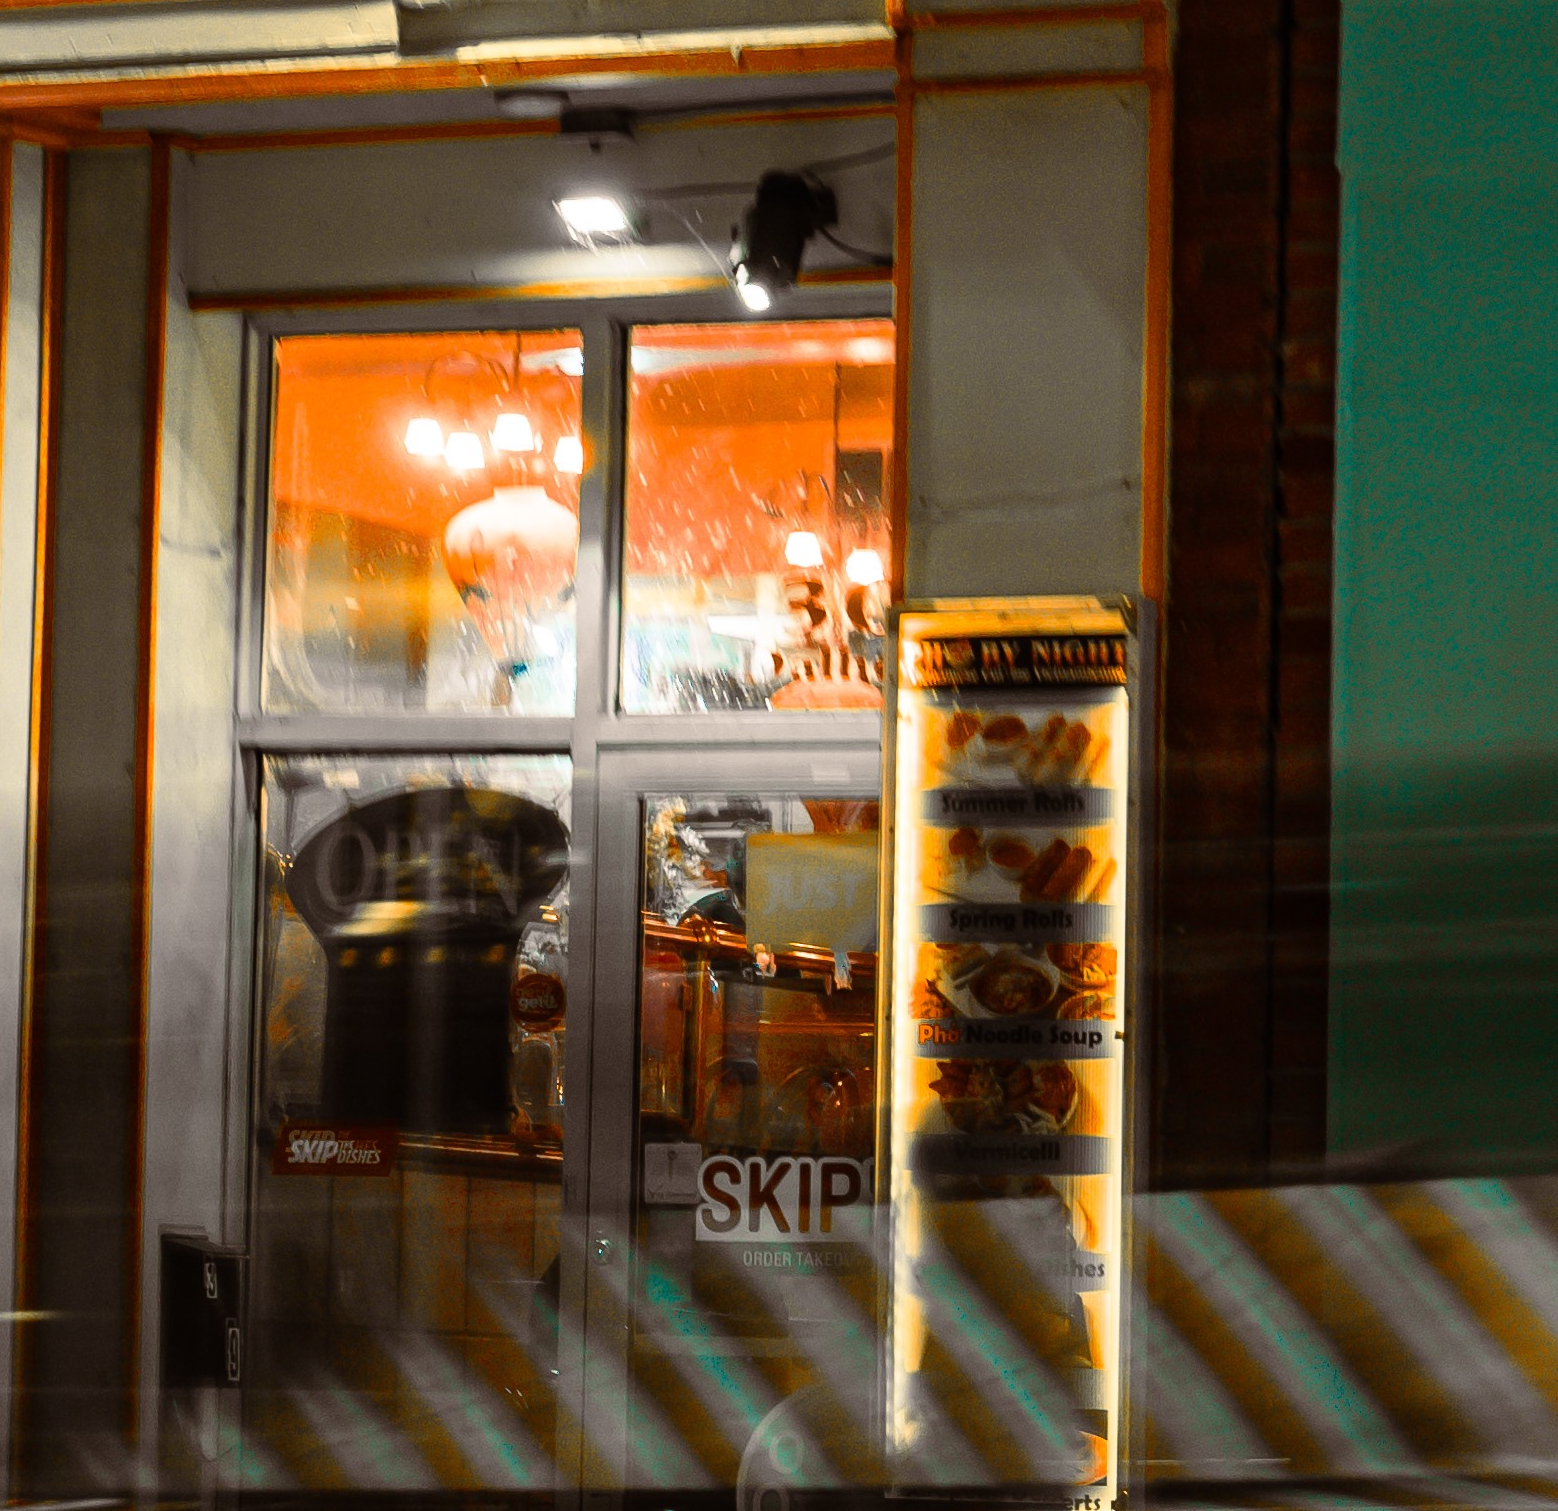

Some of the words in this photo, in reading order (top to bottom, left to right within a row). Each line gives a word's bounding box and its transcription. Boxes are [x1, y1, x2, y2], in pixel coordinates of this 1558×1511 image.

[941, 791, 1030, 815] Summer
[949, 909, 1017, 933] Spring
[1022, 909, 1074, 929] Rolls
[964, 1025, 1046, 1045] Noodle
[1051, 1025, 1104, 1049] Soup
[699, 1159, 863, 1234] SKIP
[742, 1250, 792, 1268] ORDER
